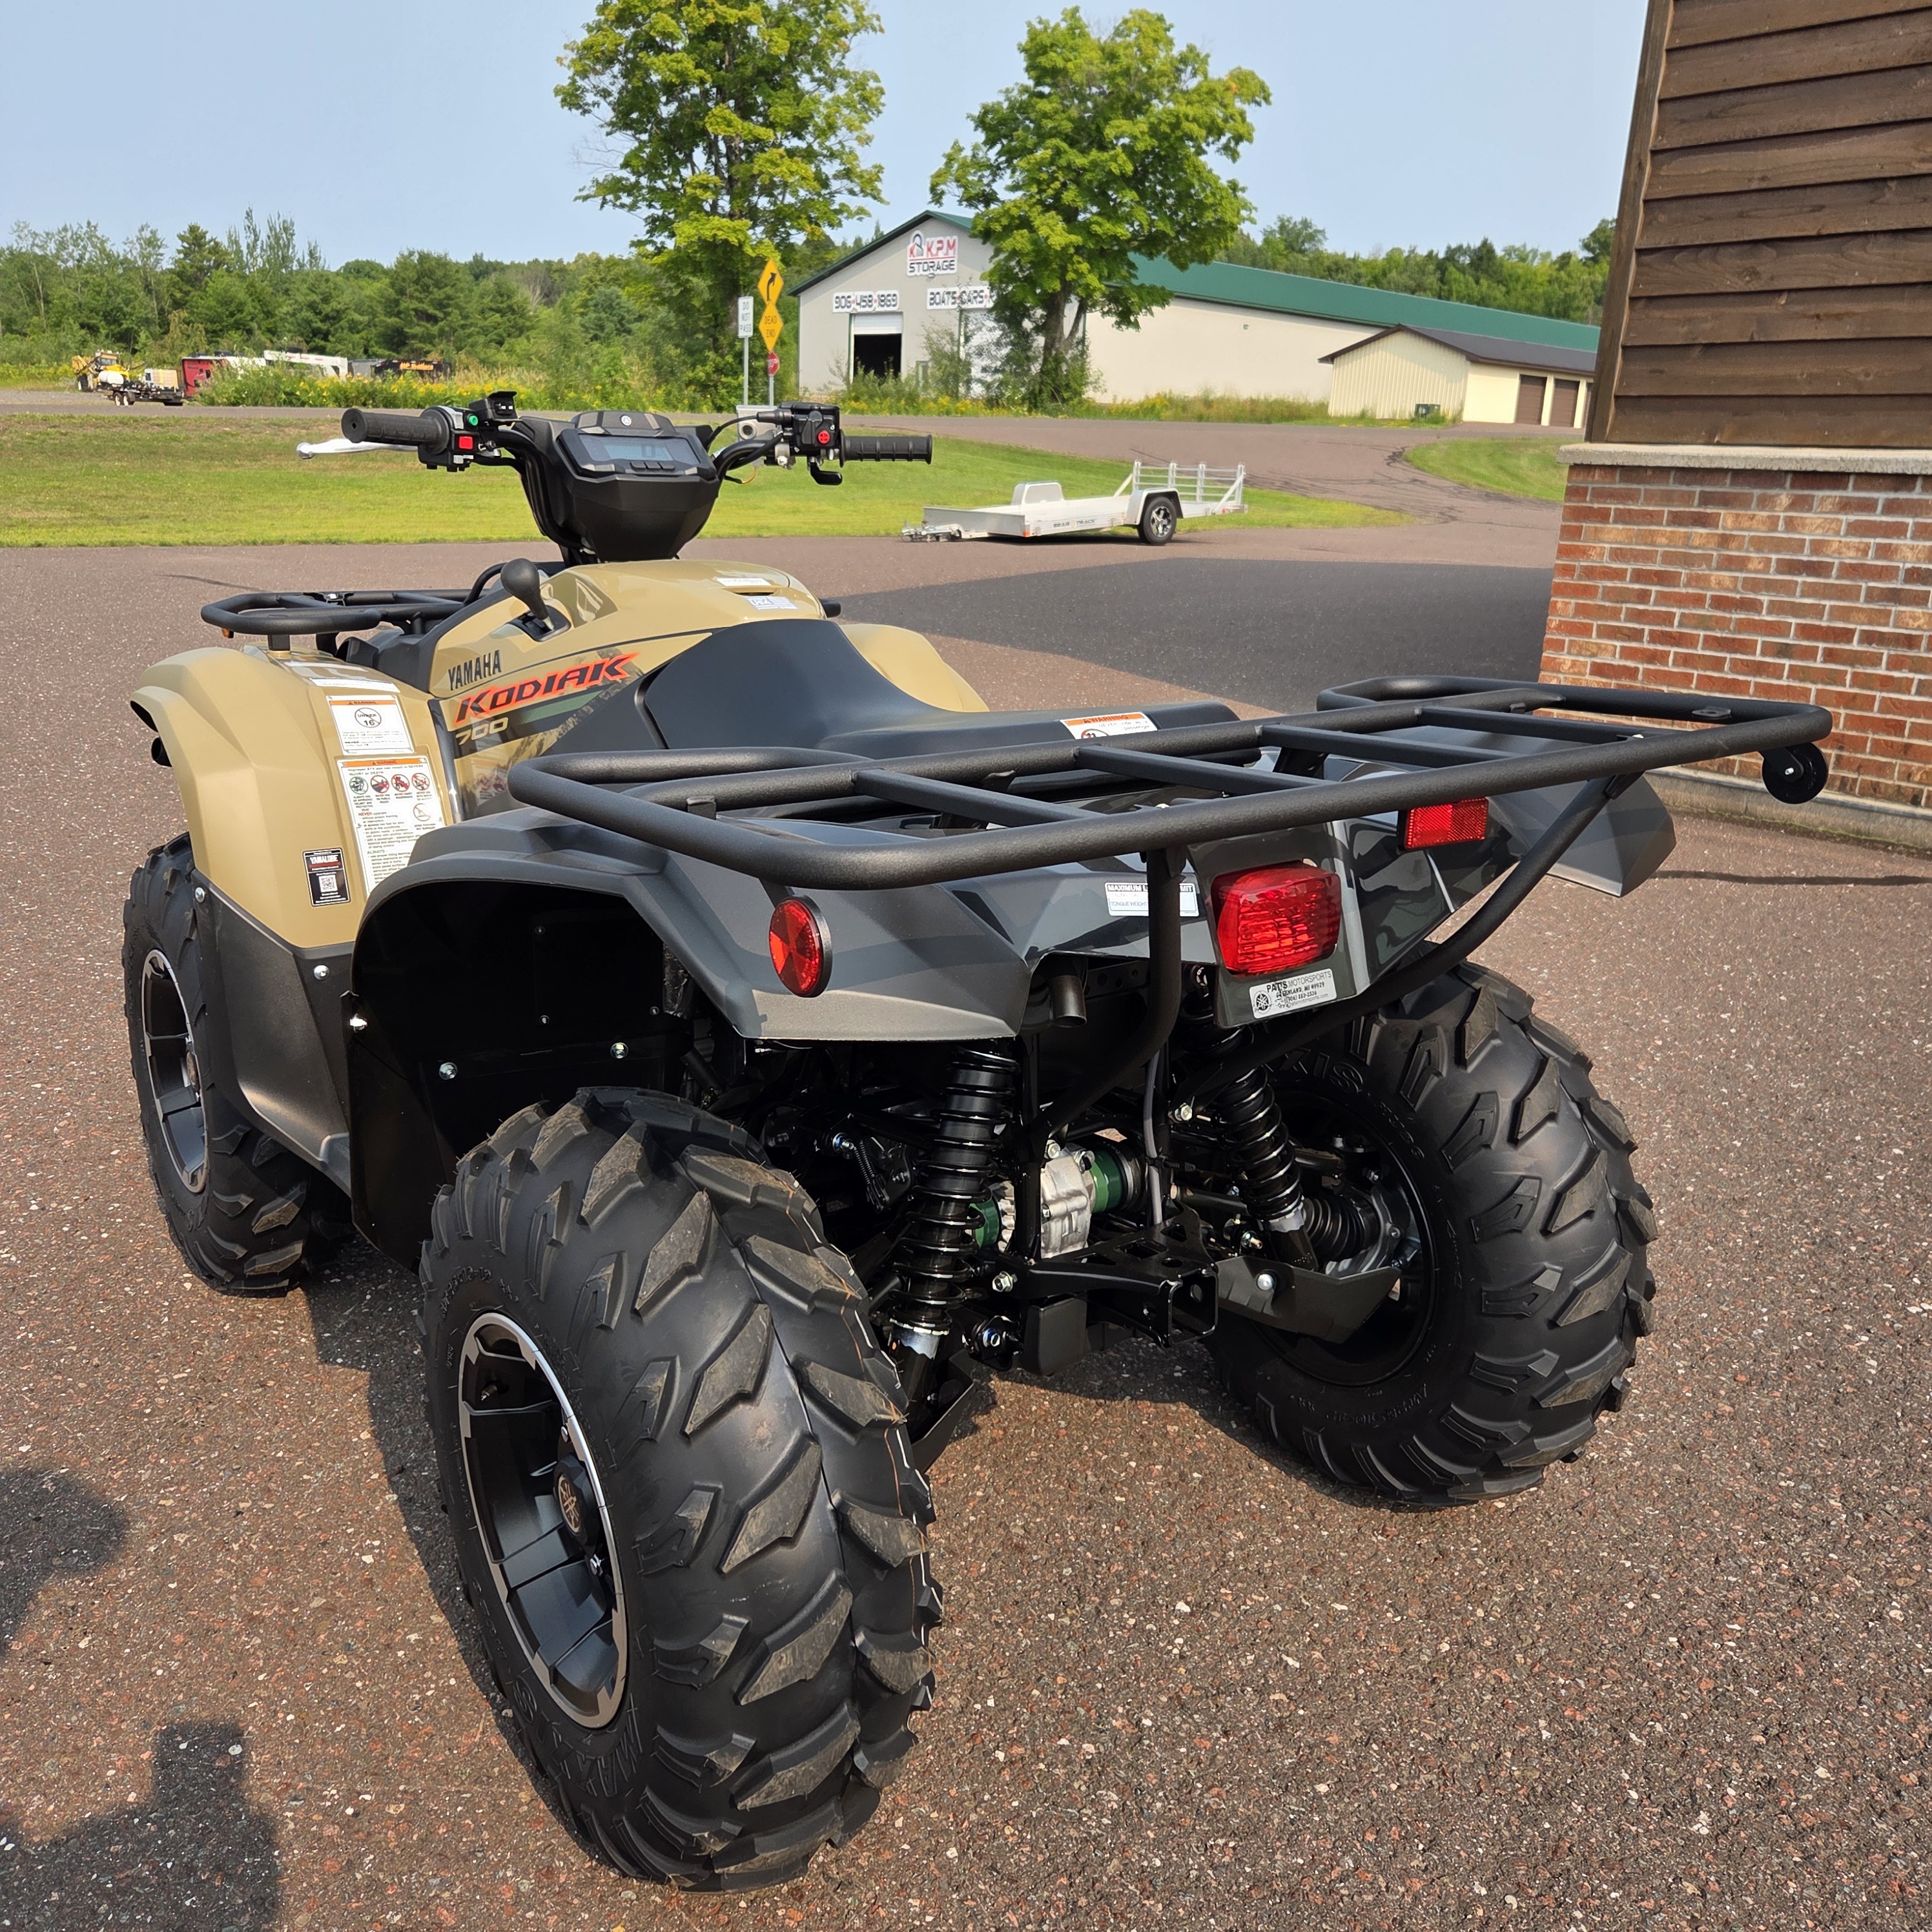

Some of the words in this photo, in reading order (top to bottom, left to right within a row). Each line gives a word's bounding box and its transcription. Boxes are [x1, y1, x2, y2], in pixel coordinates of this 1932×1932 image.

[909, 260, 956, 273] STORAGE
[765, 315, 777, 325] DEAD
[448, 650, 502, 691] YAMAHA
[455, 653, 639, 724] KODIAK
[456, 717, 509, 745] 700
[1288, 971, 1331, 988] MOTORSPORTS
